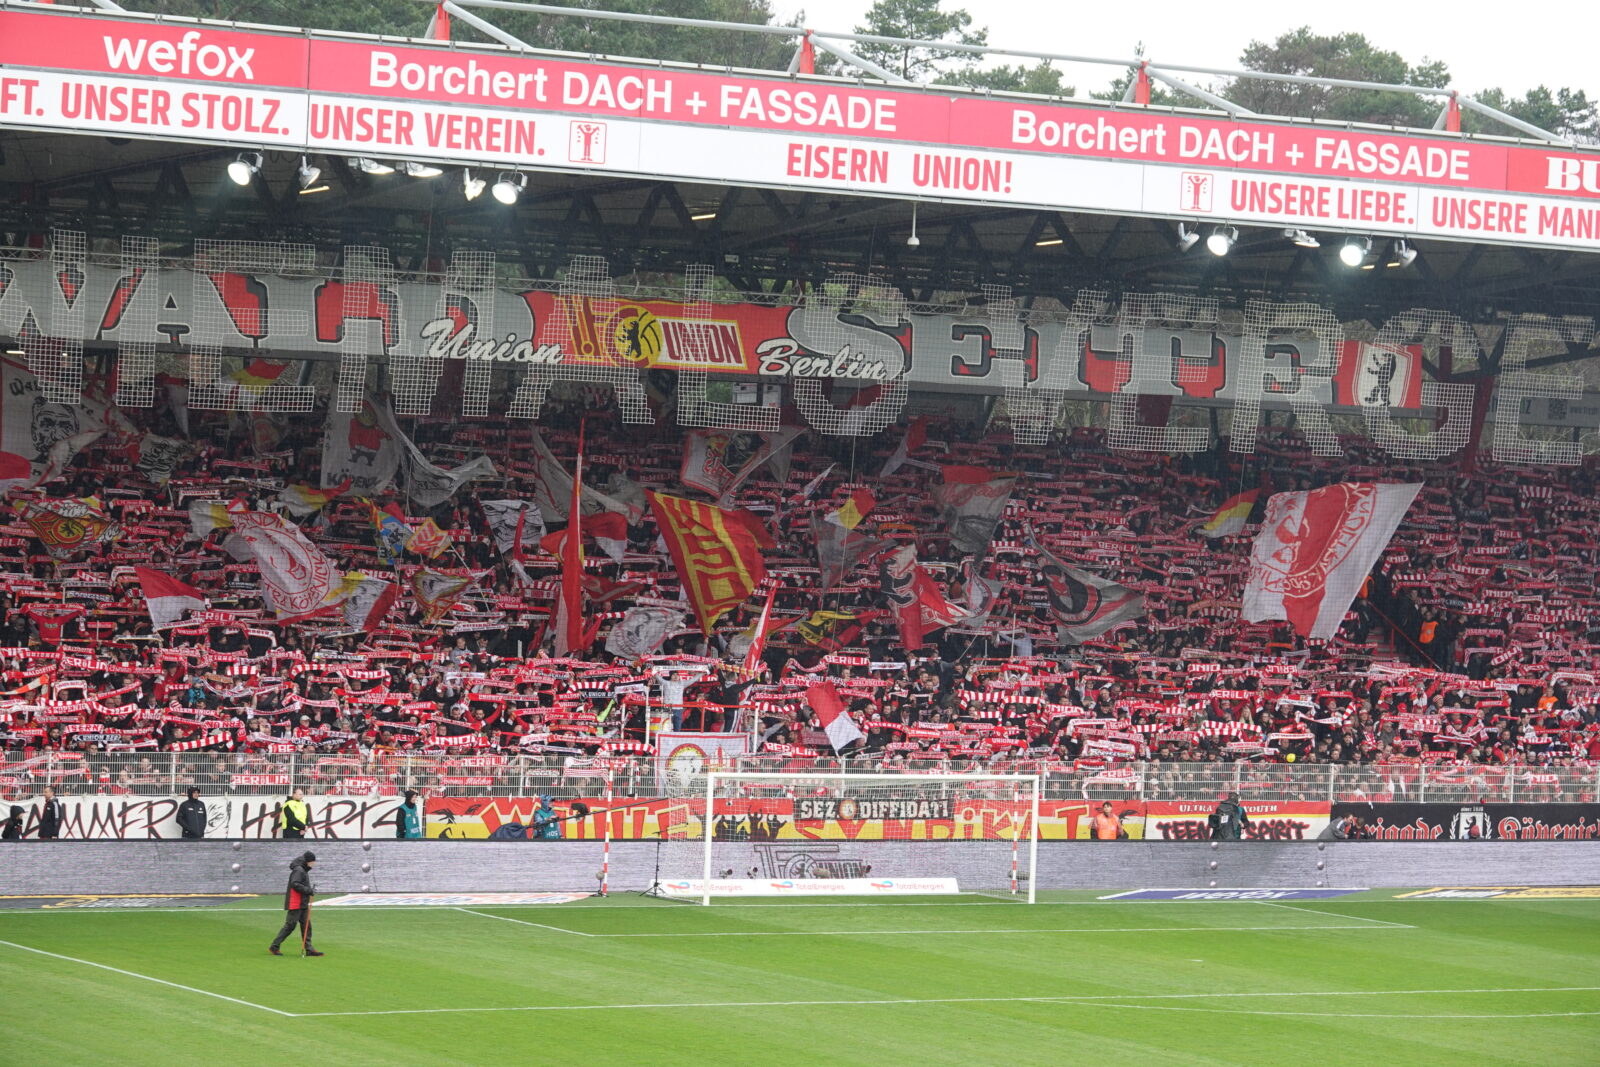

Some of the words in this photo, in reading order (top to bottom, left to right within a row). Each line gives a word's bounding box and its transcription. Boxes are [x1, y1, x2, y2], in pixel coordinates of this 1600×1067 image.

[103, 30, 256, 81] wefox
[368, 50, 550, 104] Borchert
[562, 70, 673, 115] DACH
[685, 92, 707, 115] +
[719, 84, 898, 133] FASSADE
[62, 83, 170, 124] UNSER
[182, 93, 288, 135] STOLZ.
[311, 104, 413, 144] UNSER
[425, 113, 544, 155] VEREIN.
[787, 144, 888, 182] EISERN
[914, 154, 1011, 192] UNION!
[1010, 109, 1168, 156] Borchert
[1178, 126, 1274, 165] DACH
[1286, 144, 1304, 165] +
[1314, 136, 1471, 182] FASSADE
[1232, 180, 1330, 217] UNSERE
[1338, 189, 1413, 224] LIEBE.
[1433, 197, 1527, 233] UNSERE
[421, 319, 563, 364] Union
[660, 319, 744, 366] UNION
[757, 339, 888, 381] Berlin
[1179, 804, 1213, 813] ULTRA
[1363, 817, 1443, 839] rigade
